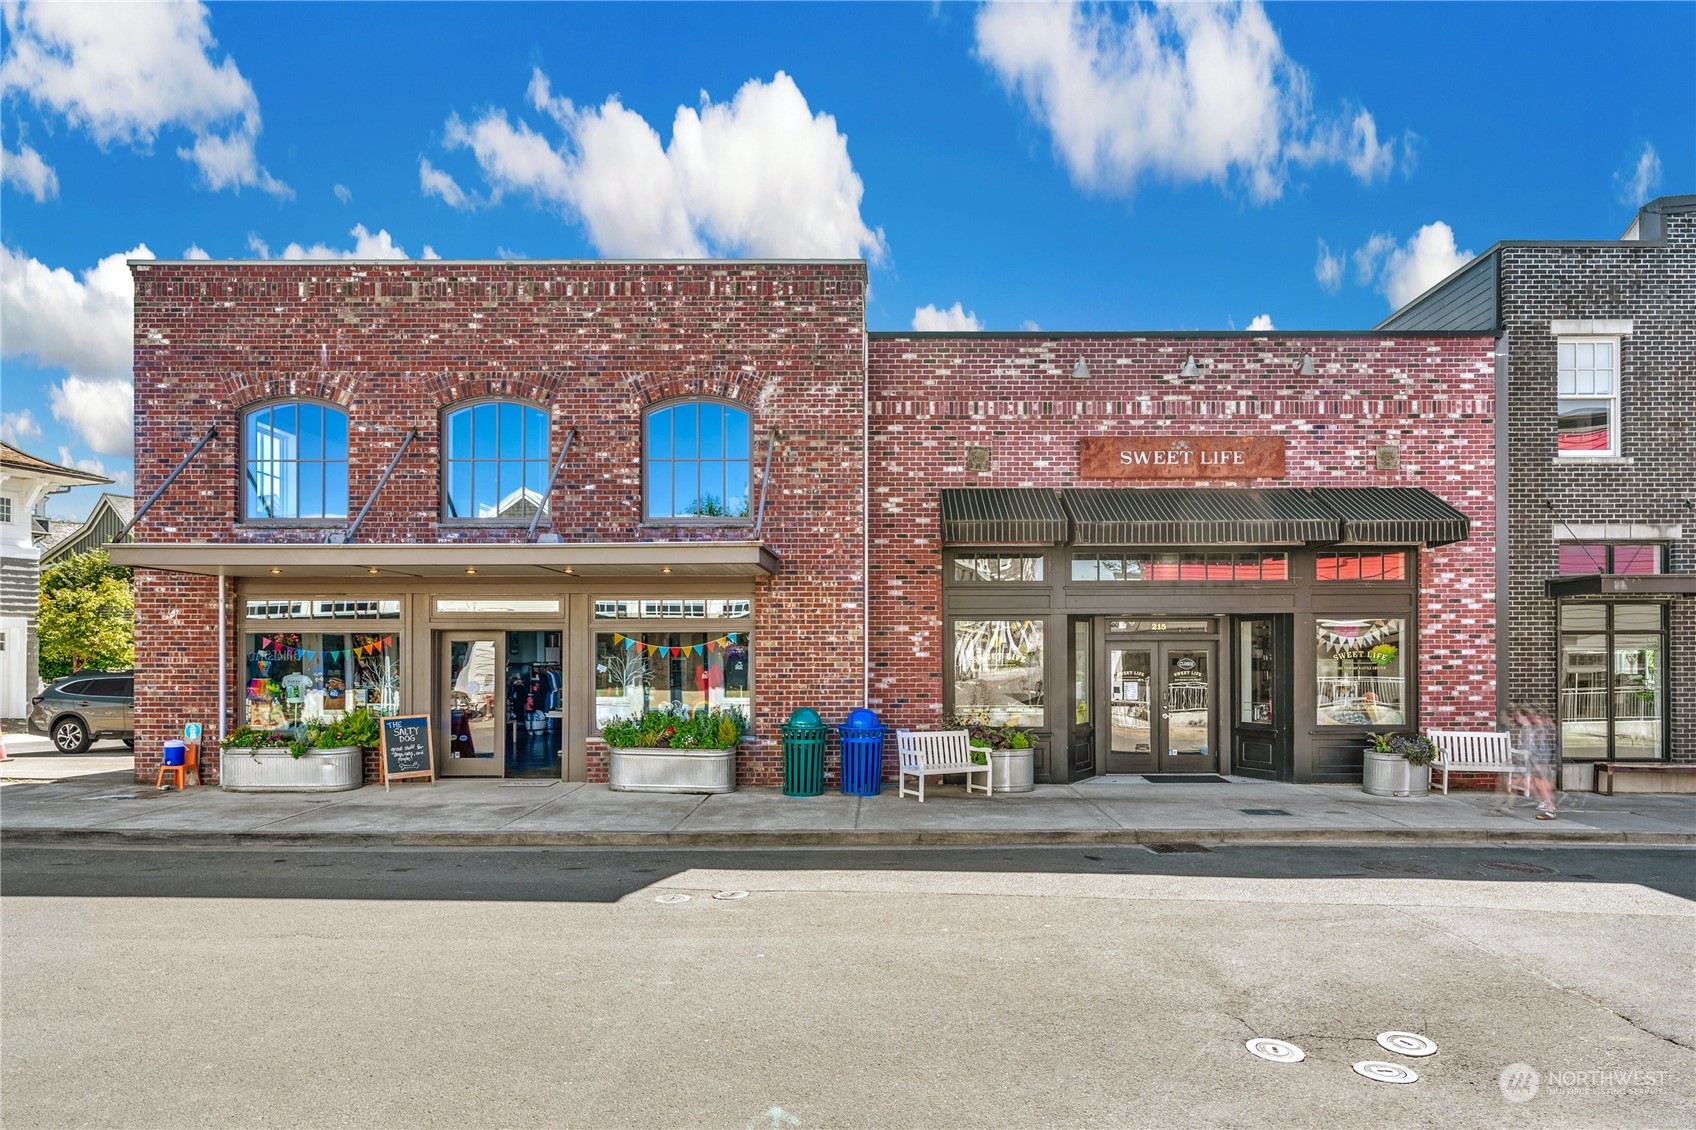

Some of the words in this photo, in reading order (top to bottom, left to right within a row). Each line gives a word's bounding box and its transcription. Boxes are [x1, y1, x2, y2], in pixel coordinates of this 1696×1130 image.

[1120, 450, 1193, 465] SWEET
[1200, 450, 1245, 465] LIFE
[1151, 623, 1167, 631] 215
[1006, 652, 1027, 663] LIFE
[1333, 650, 1364, 660] SWEET
[1367, 651, 1388, 661] LIFE
[394, 727, 419, 736] SALTY
